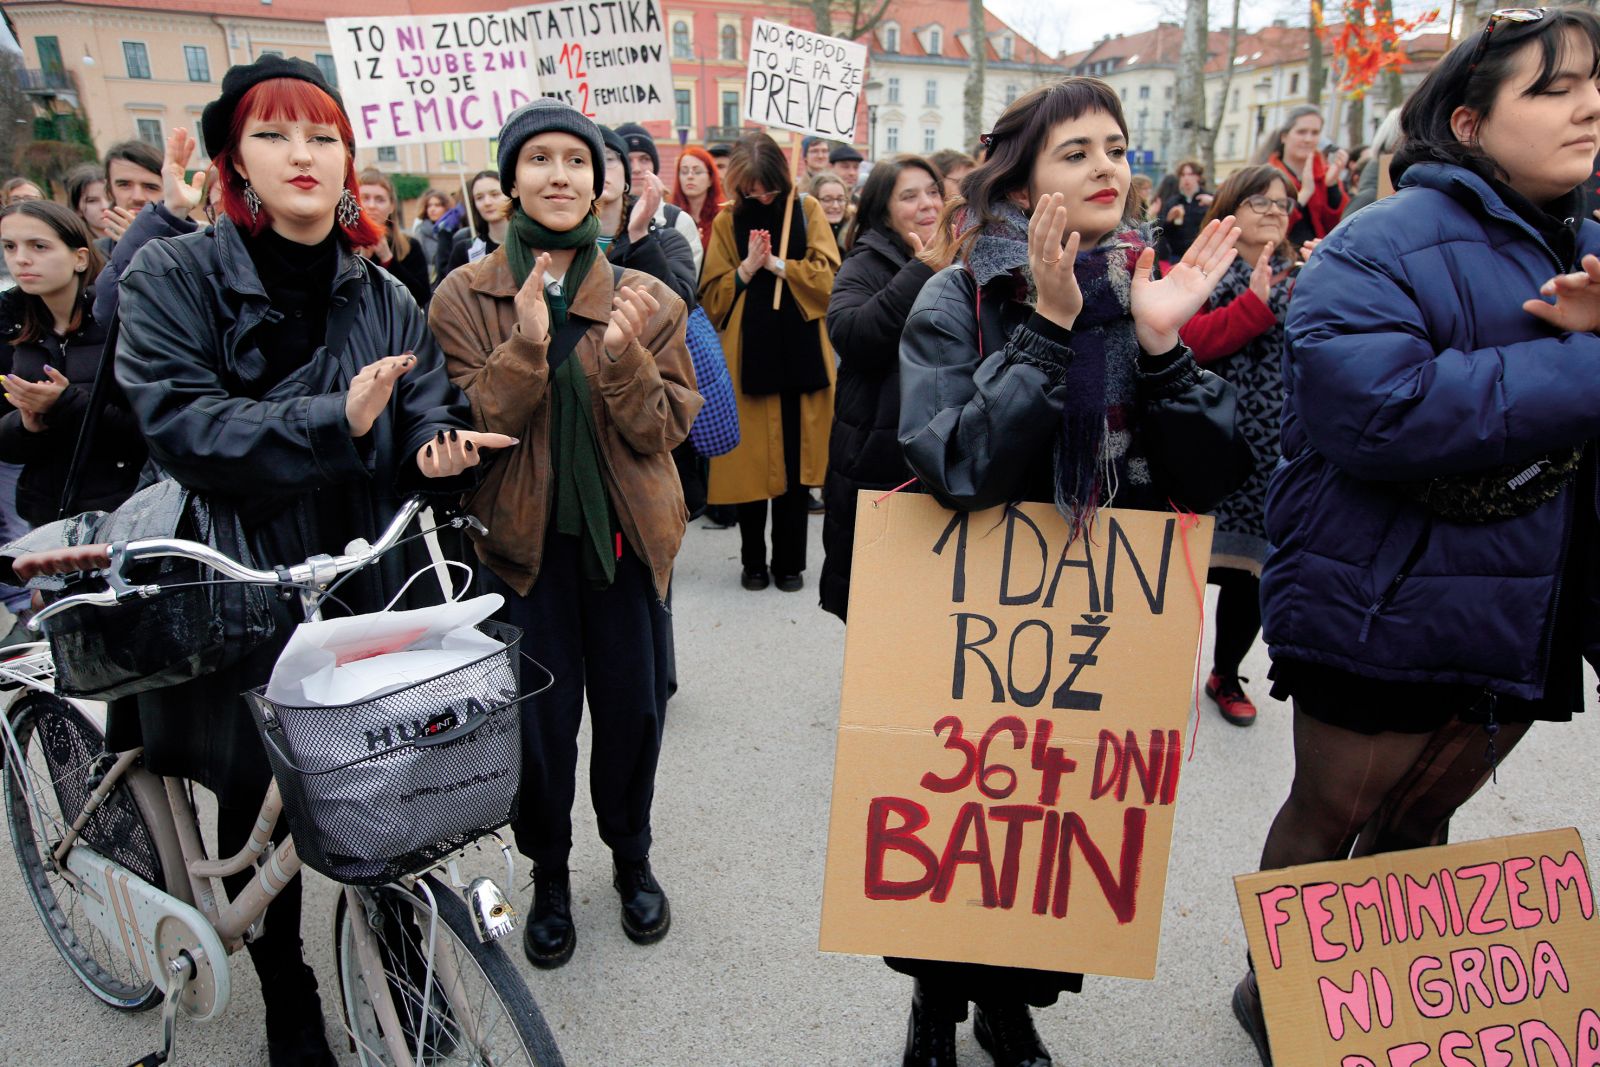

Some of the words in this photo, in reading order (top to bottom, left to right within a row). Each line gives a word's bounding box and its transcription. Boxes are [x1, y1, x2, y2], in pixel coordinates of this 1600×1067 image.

[348, 25, 385, 53] TO
[396, 26, 425, 51] NI
[432, 14, 528, 50] ZLOČIN
[785, 30, 846, 62] GOSPOD
[354, 57, 383, 80] IZ
[396, 50, 527, 79] LJUBEZNI
[559, 43, 586, 79] 12
[585, 46, 661, 69] FEMICIDOV
[753, 49, 778, 70] TO
[785, 56, 804, 76] JE
[813, 60, 831, 80] PA
[840, 62, 862, 85] ŽE
[406, 79, 435, 96] TO
[449, 75, 475, 93] JE
[578, 82, 596, 118] 2
[594, 84, 661, 108] FEMICIDA
[749, 70, 860, 138] PREVEČ!
[1507, 463, 1542, 490] PUMA
[932, 510, 969, 604] 1
[999, 504, 1176, 615] DAN
[949, 612, 1111, 711] ROŽ
[424, 716, 453, 736] POINT
[919, 715, 1078, 806] 364
[1090, 729, 1182, 806] DNI
[865, 796, 1147, 925] BATIN
[1255, 850, 1595, 970] FEMINIZEM
[1317, 966, 1394, 1041] NI
[1408, 940, 1570, 1019] GRDA
[1341, 1008, 1600, 1067] SEDA
